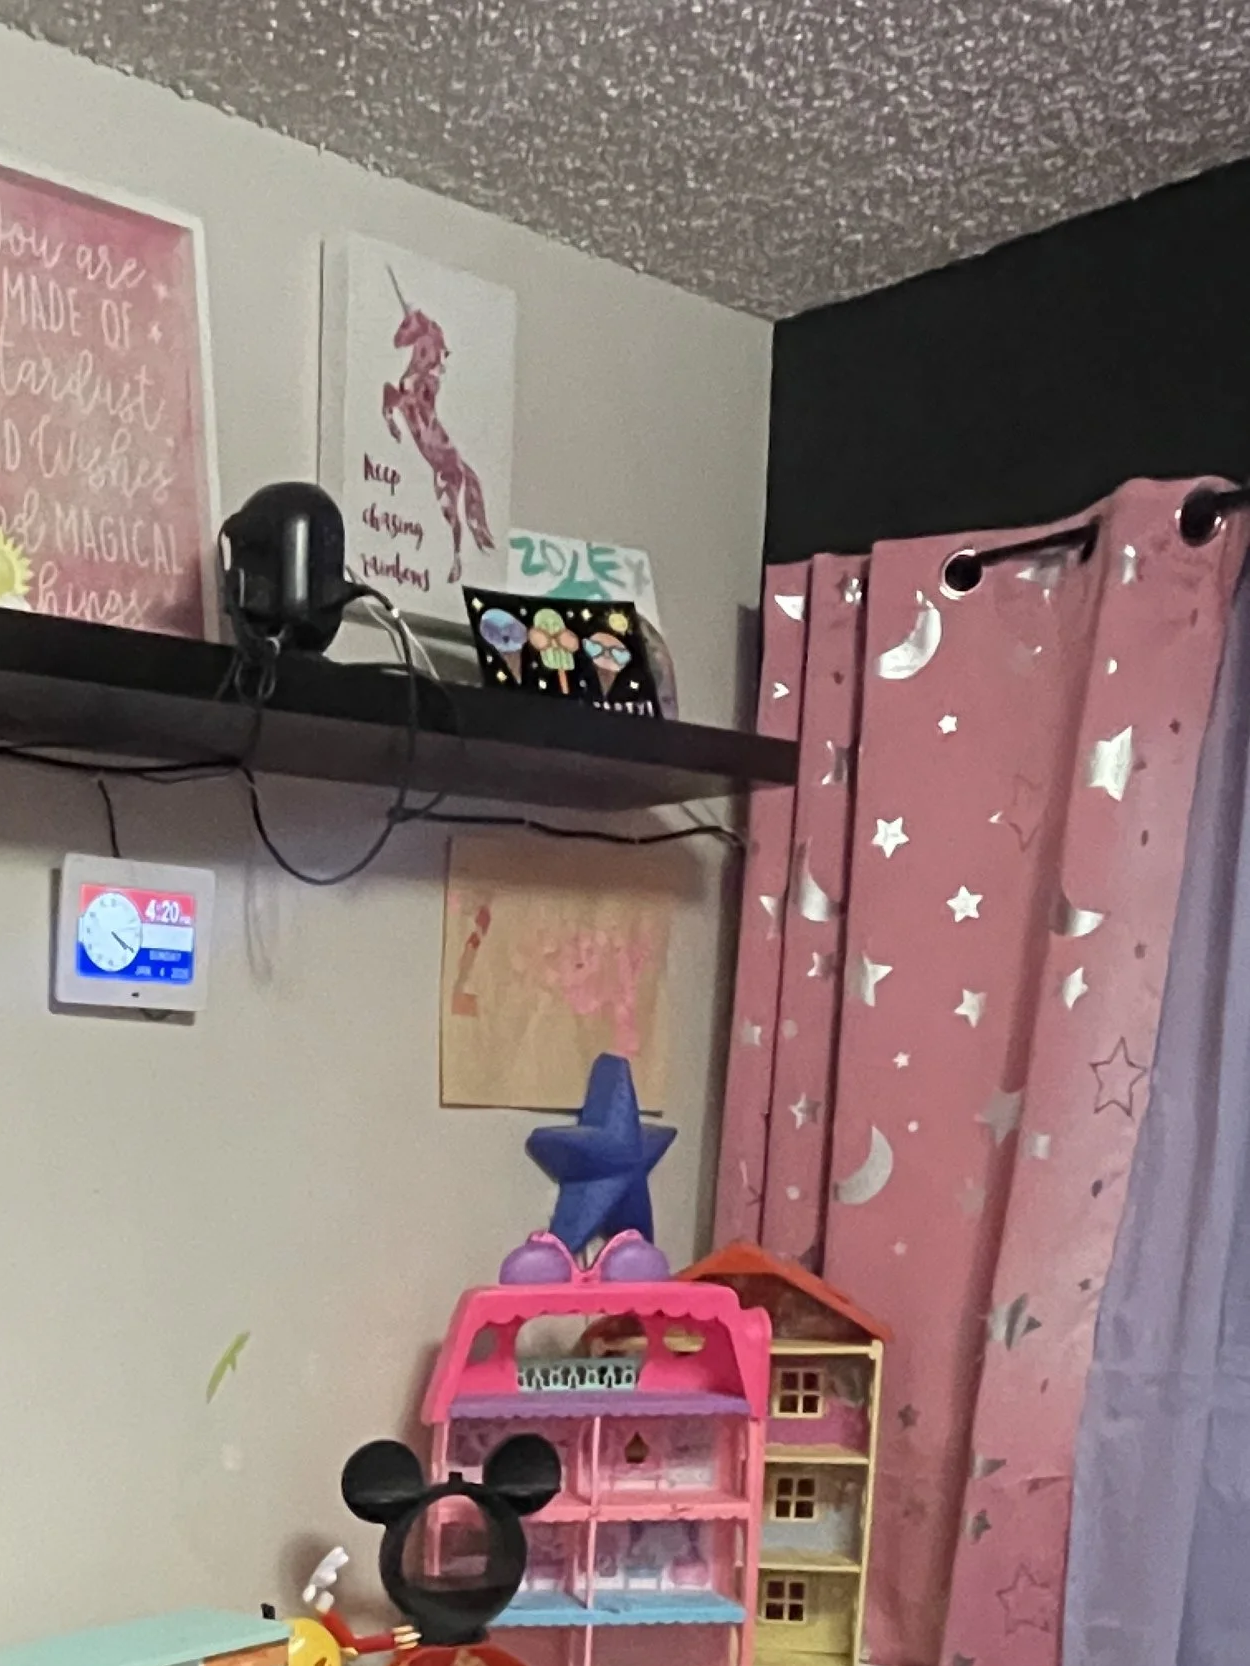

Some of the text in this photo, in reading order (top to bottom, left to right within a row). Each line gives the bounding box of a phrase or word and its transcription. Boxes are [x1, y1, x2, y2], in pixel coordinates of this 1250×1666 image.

[77, 244, 146, 290] are
[2, 266, 133, 351] MADE OF
[55, 501, 184, 576] MAGICAL
[362, 502, 423, 551] chasing
[36, 561, 151, 627] hings
